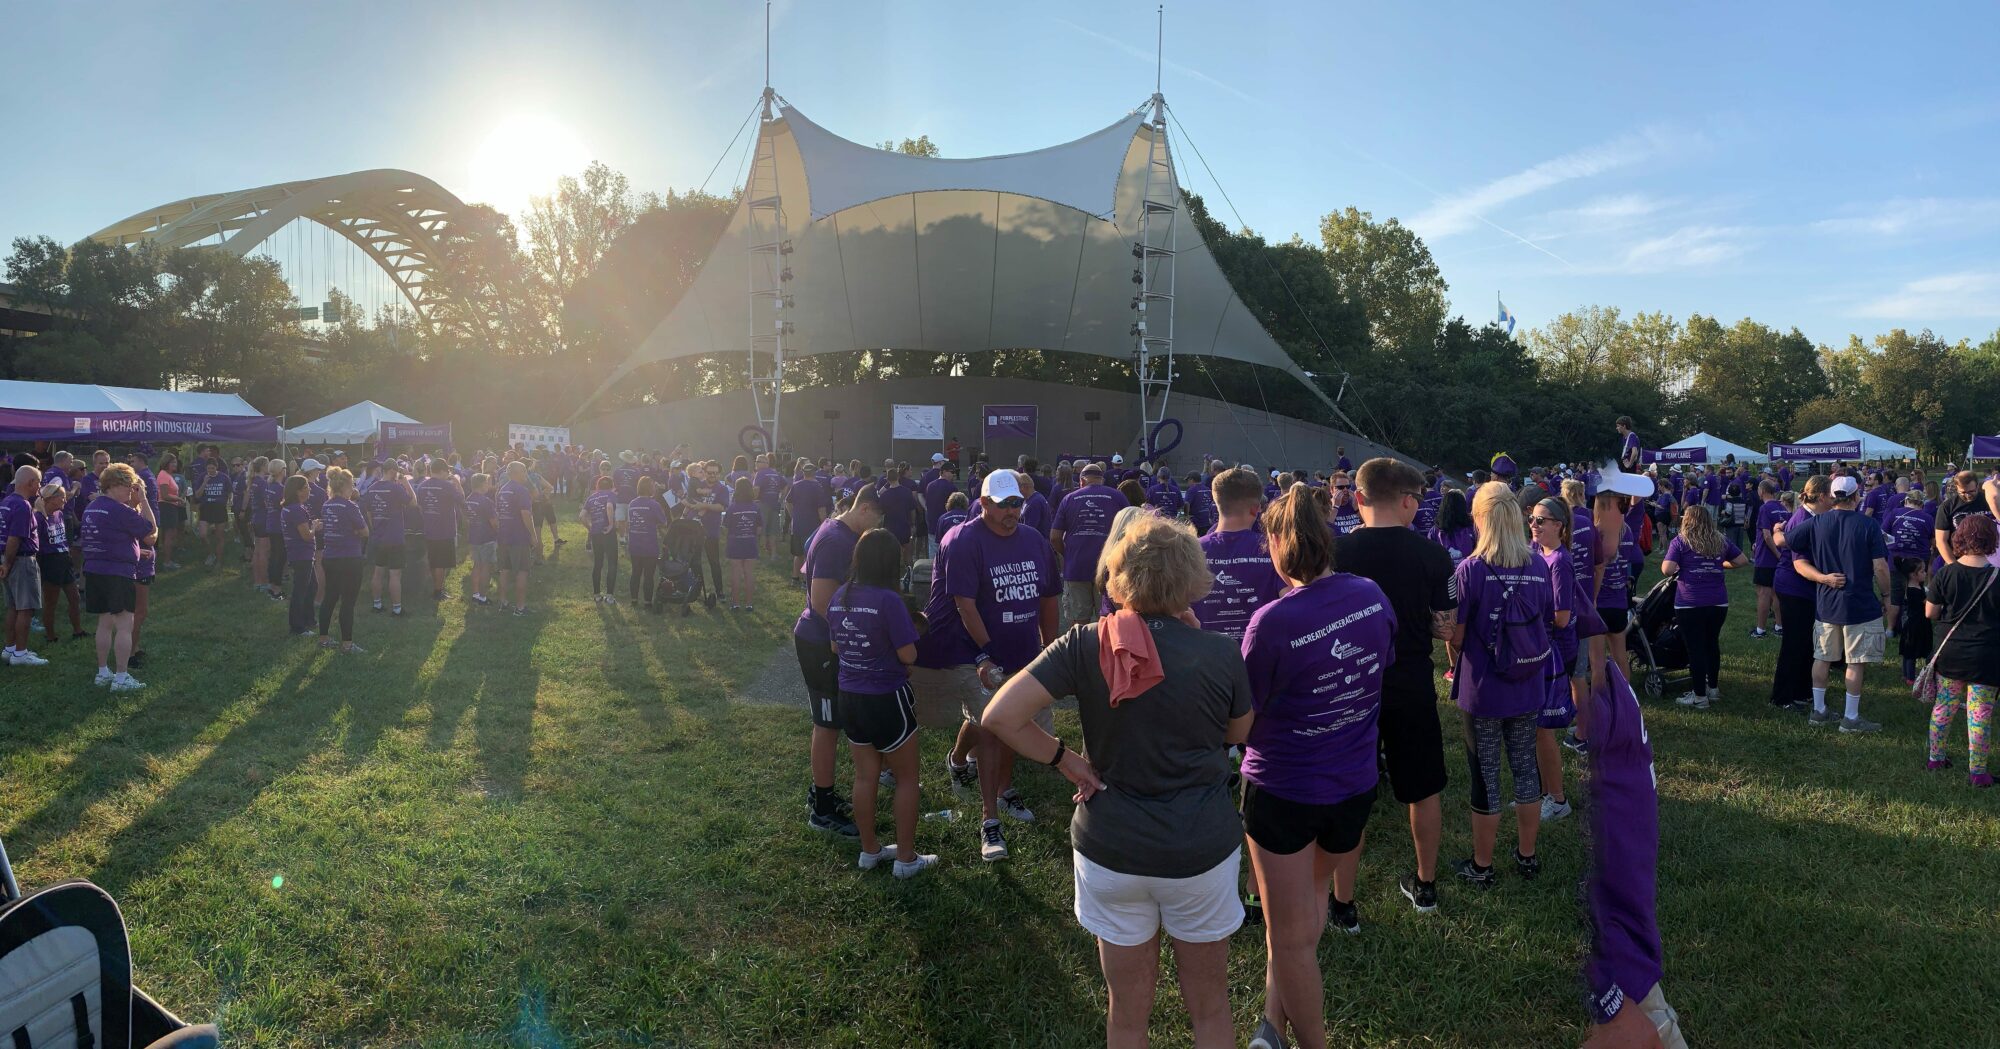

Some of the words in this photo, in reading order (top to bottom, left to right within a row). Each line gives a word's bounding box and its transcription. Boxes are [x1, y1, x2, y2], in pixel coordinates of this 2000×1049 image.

[102, 419, 152, 433] RICHARDS
[154, 420, 212, 434] INDUSTRIALS
[1800, 447, 1829, 455] BIOMEDICAL
[1829, 446, 1858, 454] SOLUTIONS
[989, 567, 994, 577] I
[994, 562, 1014, 576] WALK
[1012, 563, 1021, 574] TO
[1021, 560, 1036, 571] END
[992, 571, 1039, 588] PANCREATIC
[995, 583, 1040, 603] CANCER.
[1290, 628, 1328, 649] PANCREATIC
[1325, 619, 1345, 635] CANCER
[1341, 610, 1365, 627] ACTION
